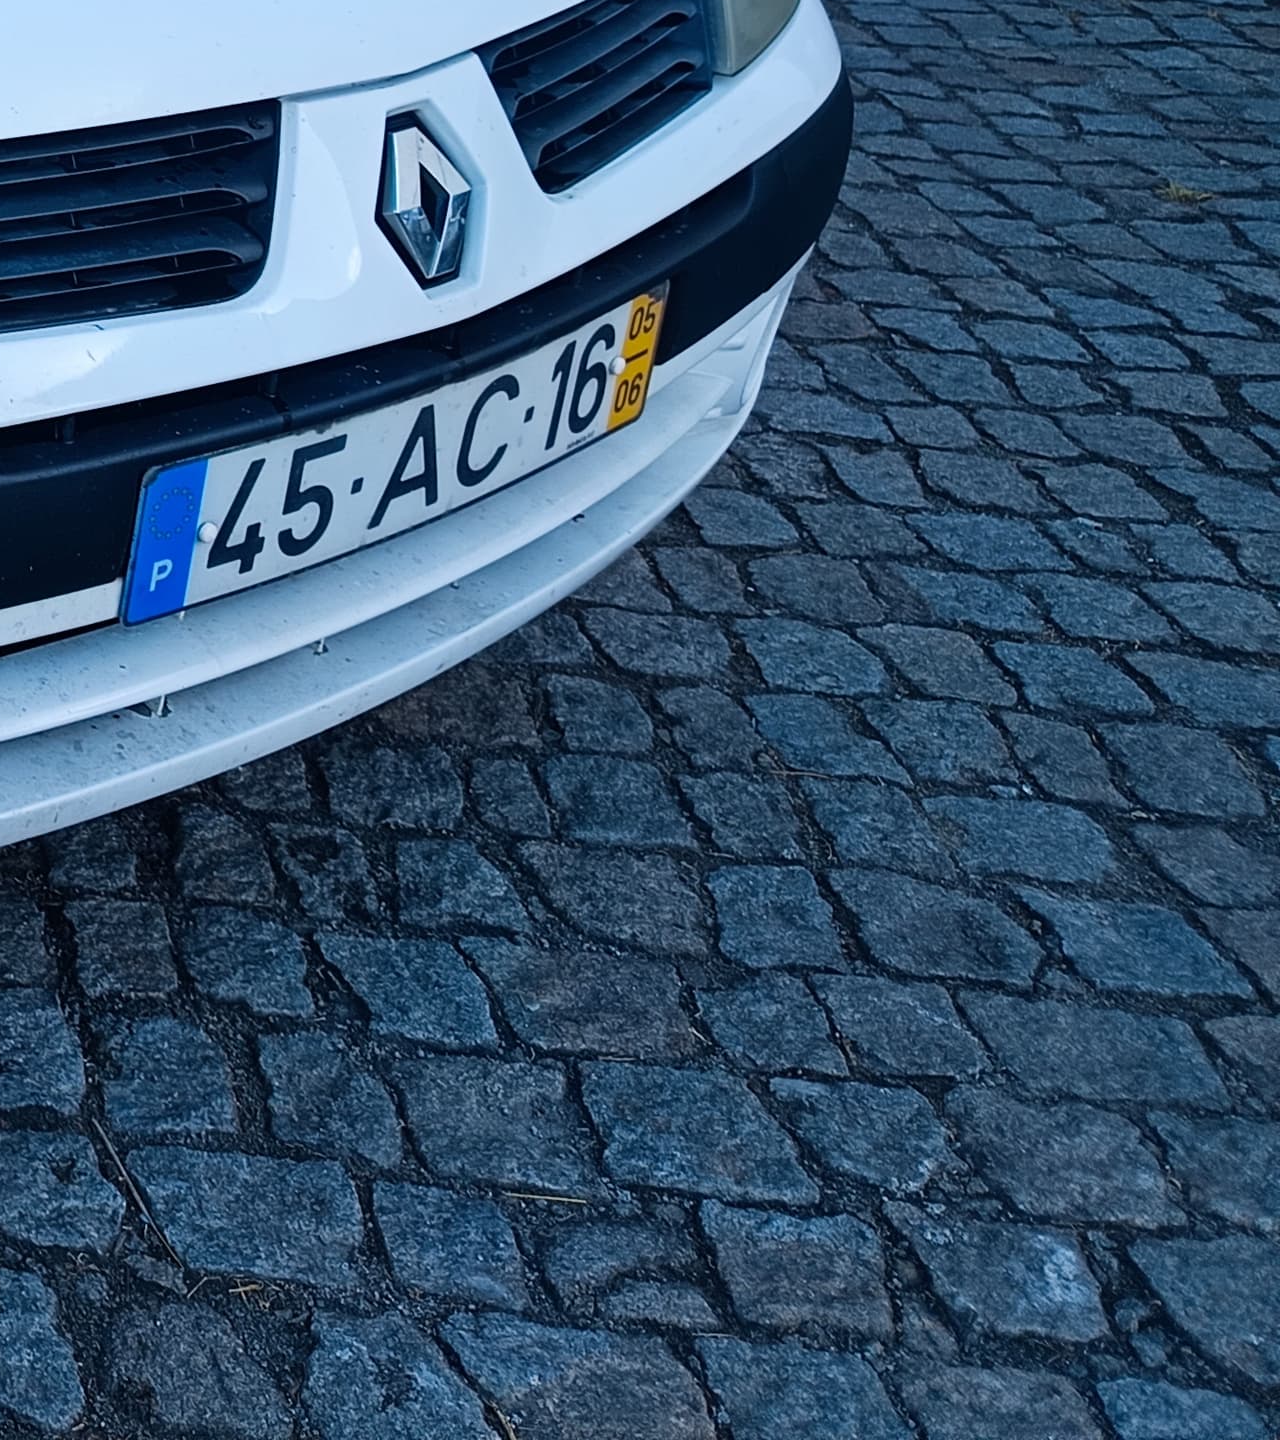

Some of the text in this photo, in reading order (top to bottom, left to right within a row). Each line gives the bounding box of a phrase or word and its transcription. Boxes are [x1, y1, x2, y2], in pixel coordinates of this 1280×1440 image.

[629, 301, 656, 340] 05
[614, 372, 643, 413] 06
[149, 559, 173, 592] P
